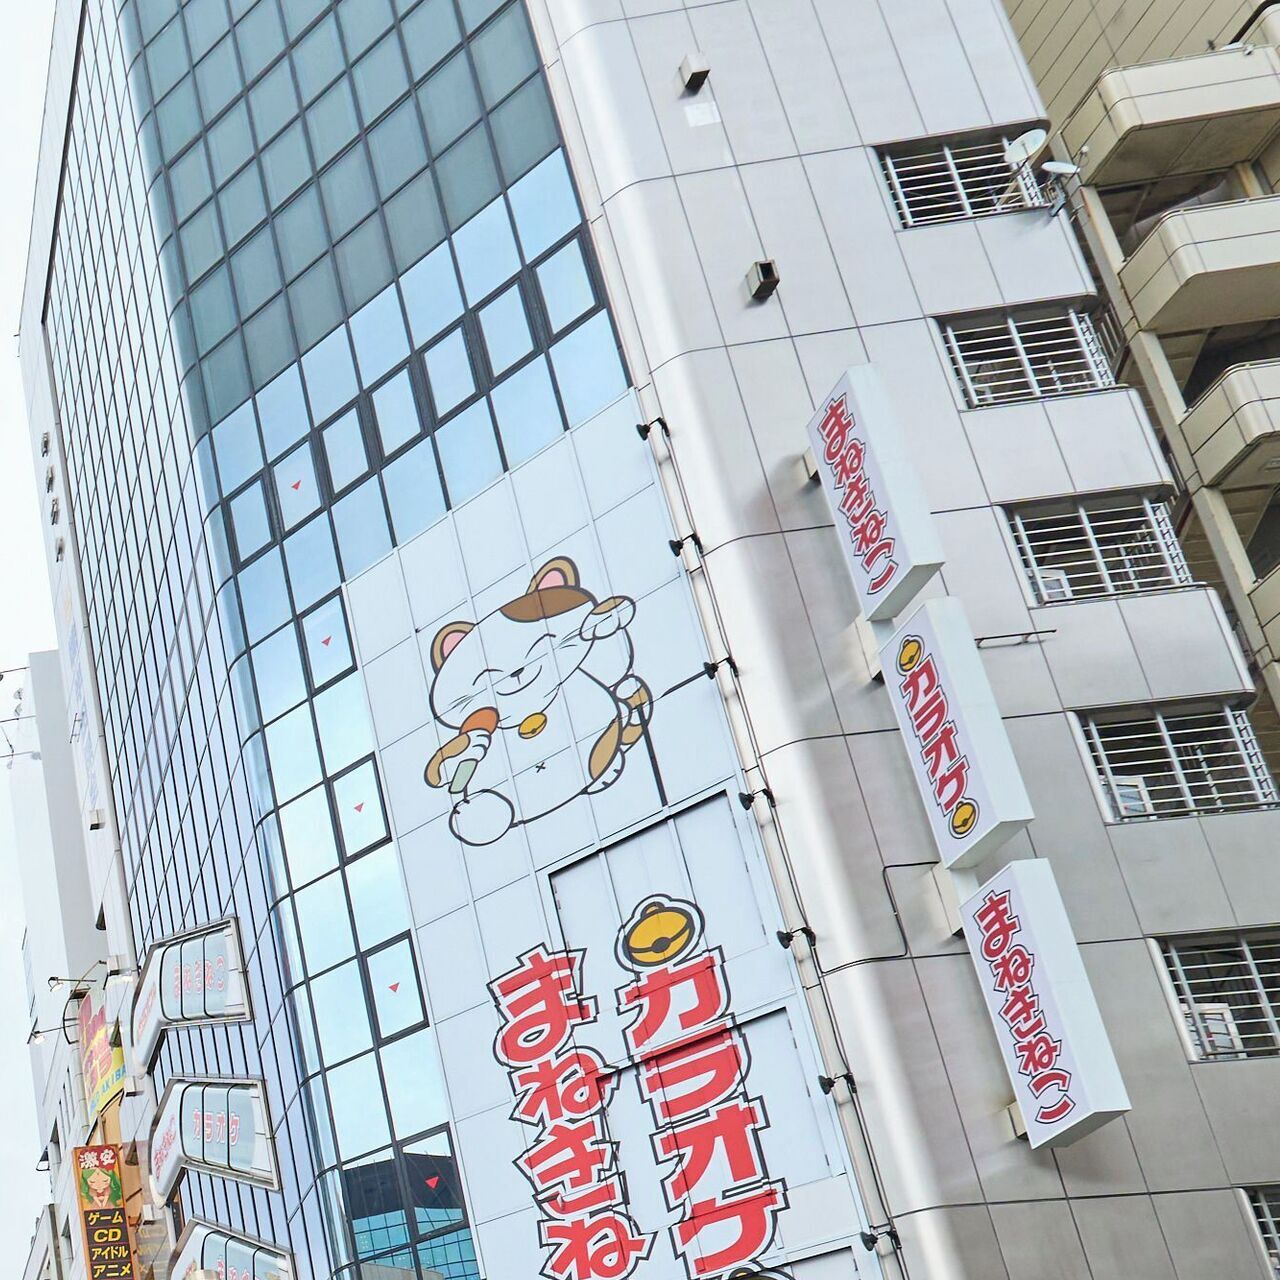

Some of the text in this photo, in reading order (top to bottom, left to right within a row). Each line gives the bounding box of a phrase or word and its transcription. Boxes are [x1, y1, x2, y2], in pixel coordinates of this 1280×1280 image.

[817, 391, 899, 595] まねきねこ
[902, 660, 970, 814] カラオケ
[173, 955, 225, 996] まねきねこ
[972, 889, 1078, 1126] まねきねこ
[193, 1109, 241, 1146] カラオケ
[618, 944, 789, 1276] カラオケ
[80, 1149, 116, 1169] 激安
[88, 1209, 124, 1226] ゲーム
[93, 1229, 122, 1243] CD
[91, 1246, 129, 1261] アイドル
[93, 1263, 132, 1278] アニメ
